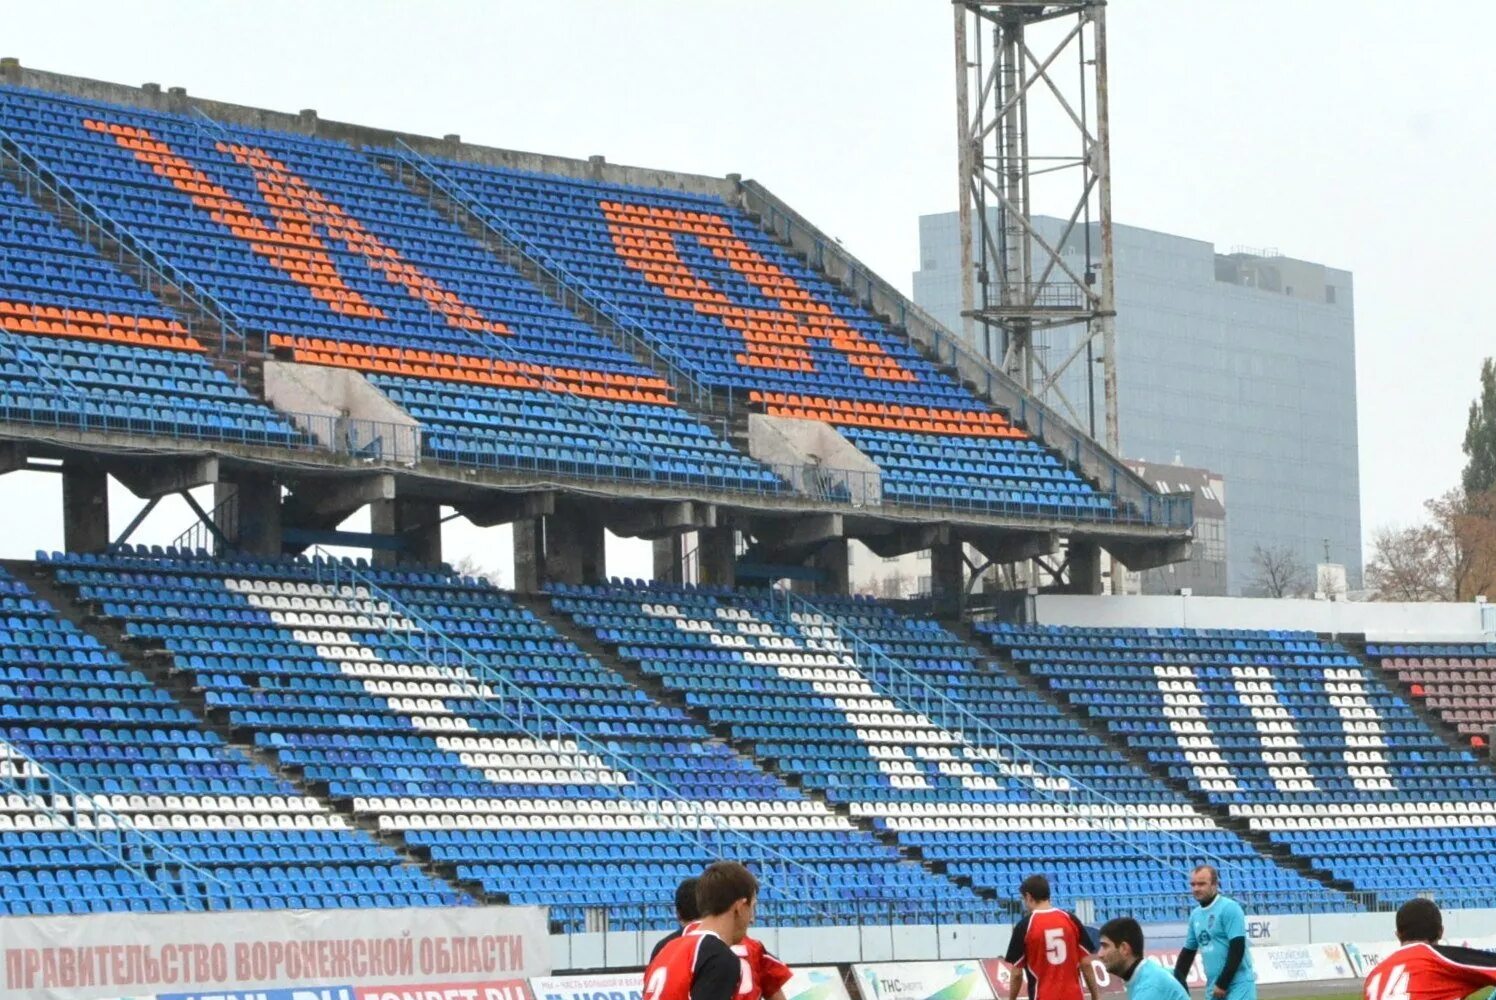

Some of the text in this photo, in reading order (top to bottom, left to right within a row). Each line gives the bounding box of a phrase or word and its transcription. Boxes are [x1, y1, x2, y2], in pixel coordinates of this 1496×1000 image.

[6, 929, 523, 990] ПРАВИТЕЛЬСТВО ВОРОНЕЖСКОЙ ОБЛАСТИ
[1044, 927, 1067, 965] 5
[880, 979, 901, 992] ТНС
